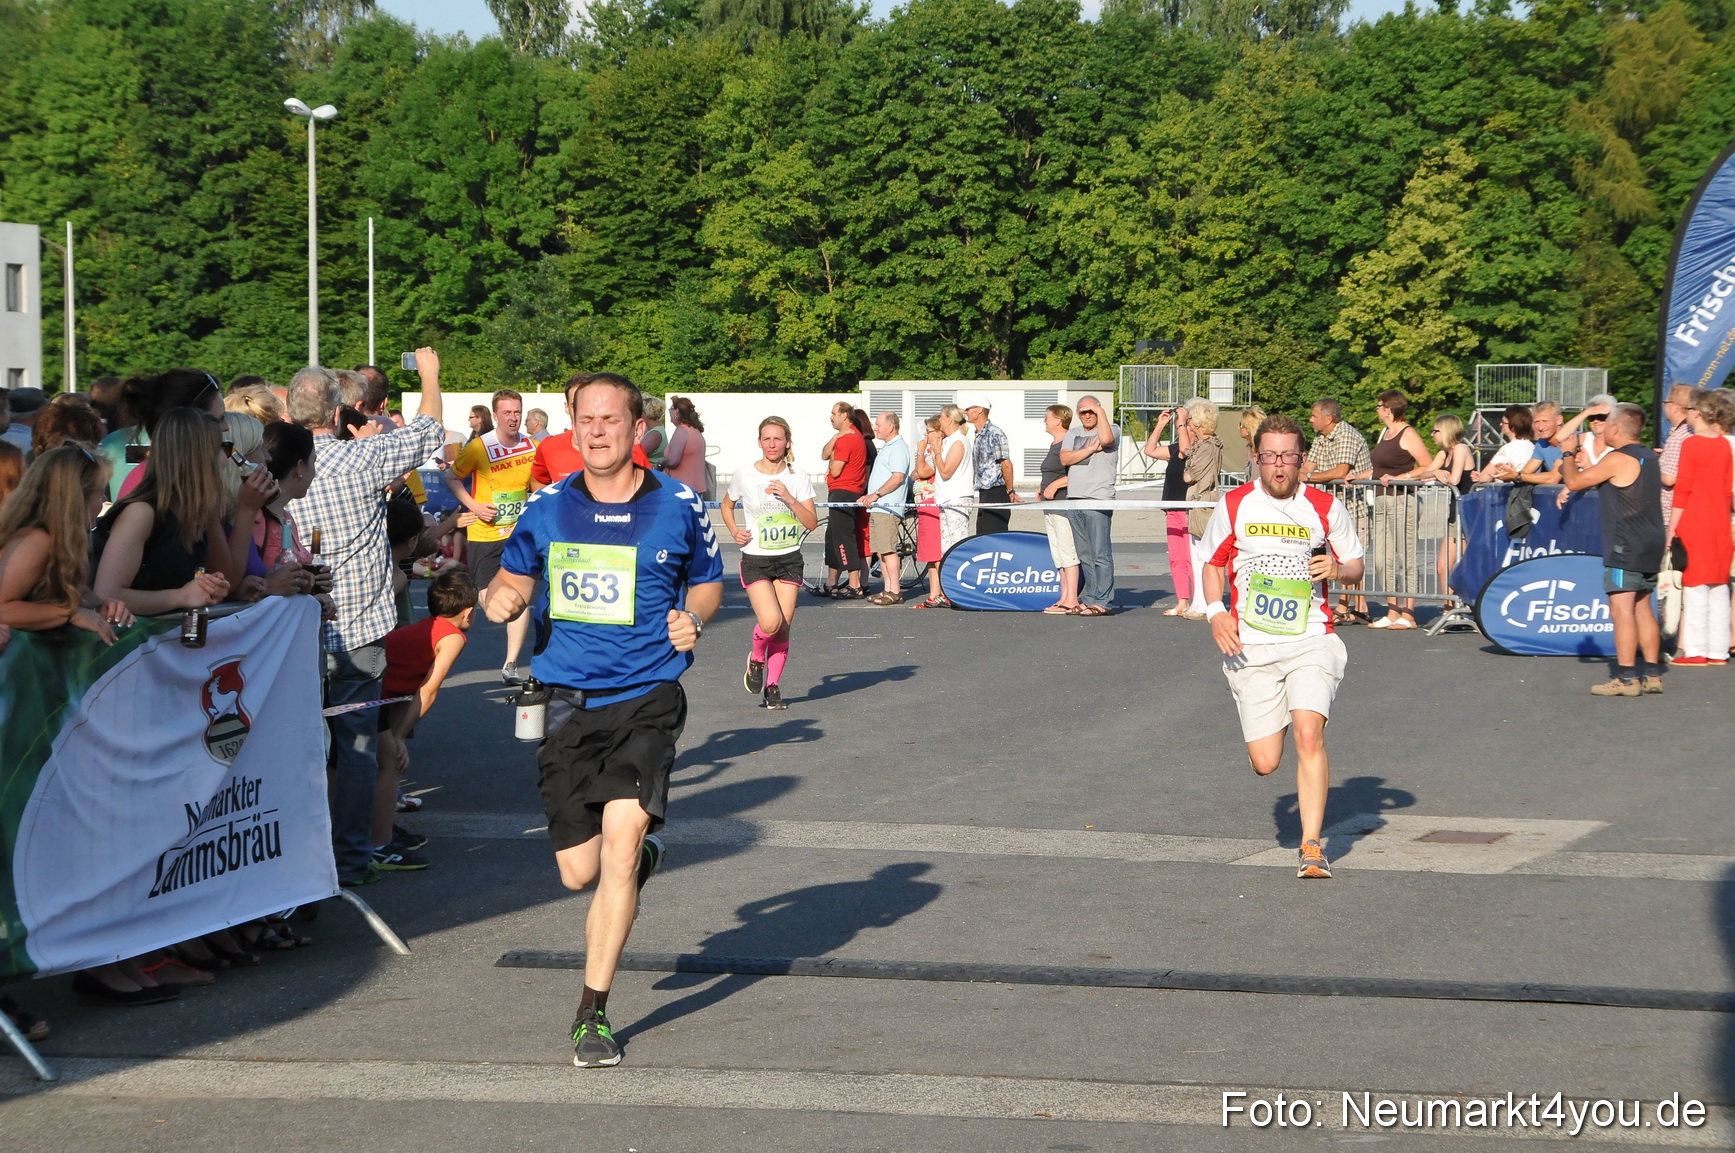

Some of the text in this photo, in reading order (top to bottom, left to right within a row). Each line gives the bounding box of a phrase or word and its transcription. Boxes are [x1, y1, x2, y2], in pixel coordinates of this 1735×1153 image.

[1673, 255, 1735, 347] Frisch
[490, 455, 536, 473] MAX BÖG
[498, 502, 521, 517] 828
[594, 512, 631, 523] hummel
[761, 525, 797, 541] 1014
[1248, 525, 1305, 538] ONLINE
[1281, 537, 1310, 547] Germany
[1501, 538, 1586, 568] Fisch
[561, 571, 620, 604] 653
[984, 585, 1060, 594] AUTOMOBILE
[1254, 593, 1299, 621] 908
[148, 812, 282, 899] Lammsbräu
